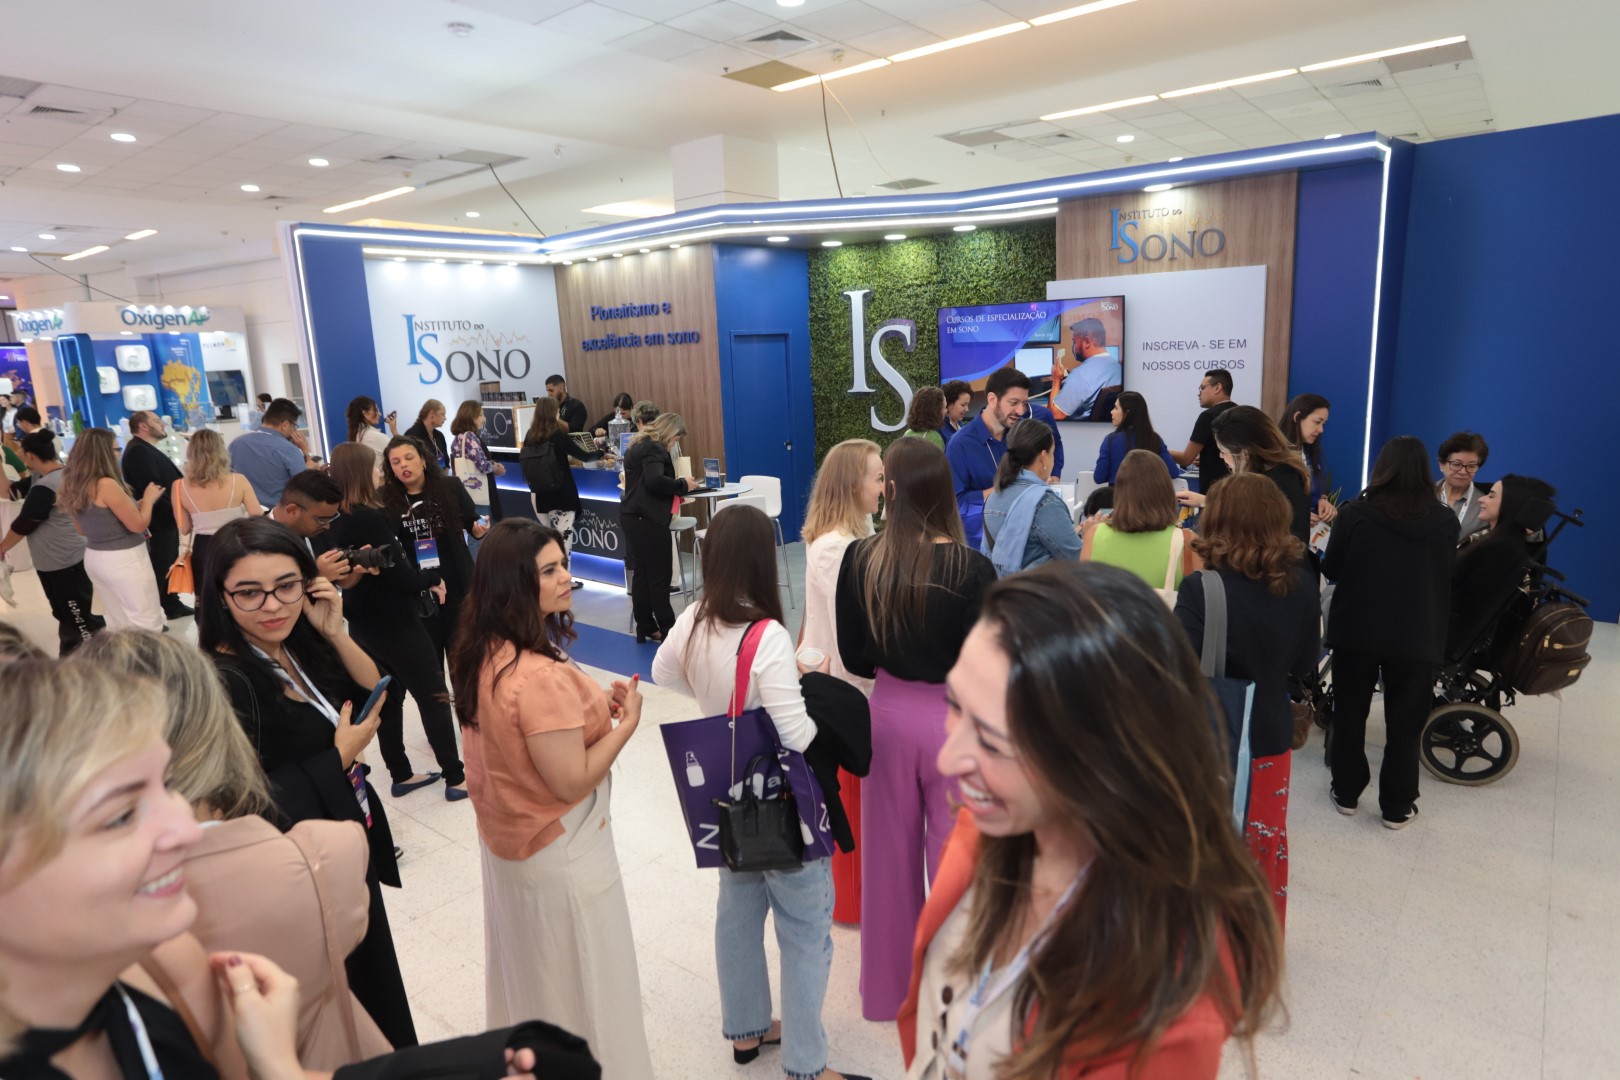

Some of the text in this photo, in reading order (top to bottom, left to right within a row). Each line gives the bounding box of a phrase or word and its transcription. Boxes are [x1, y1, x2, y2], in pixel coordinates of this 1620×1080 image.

[1117, 219, 1226, 264] SONO
[590, 302, 671, 321] Pioneirismo e
[975, 314, 986, 323] DE
[987, 310, 1047, 322] ESPECIALIZAÇÃO
[473, 322, 485, 331] DO
[946, 325, 980, 334] EM SONO
[581, 330, 700, 352] excelência em sono
[1142, 340, 1200, 352] INSCREVA
[1209, 339, 1225, 350] SE
[1228, 338, 1247, 349] EM
[416, 332, 532, 385] SONO
[843, 289, 914, 432] IS
[1142, 359, 1246, 371] NOSSOS CURSOS
